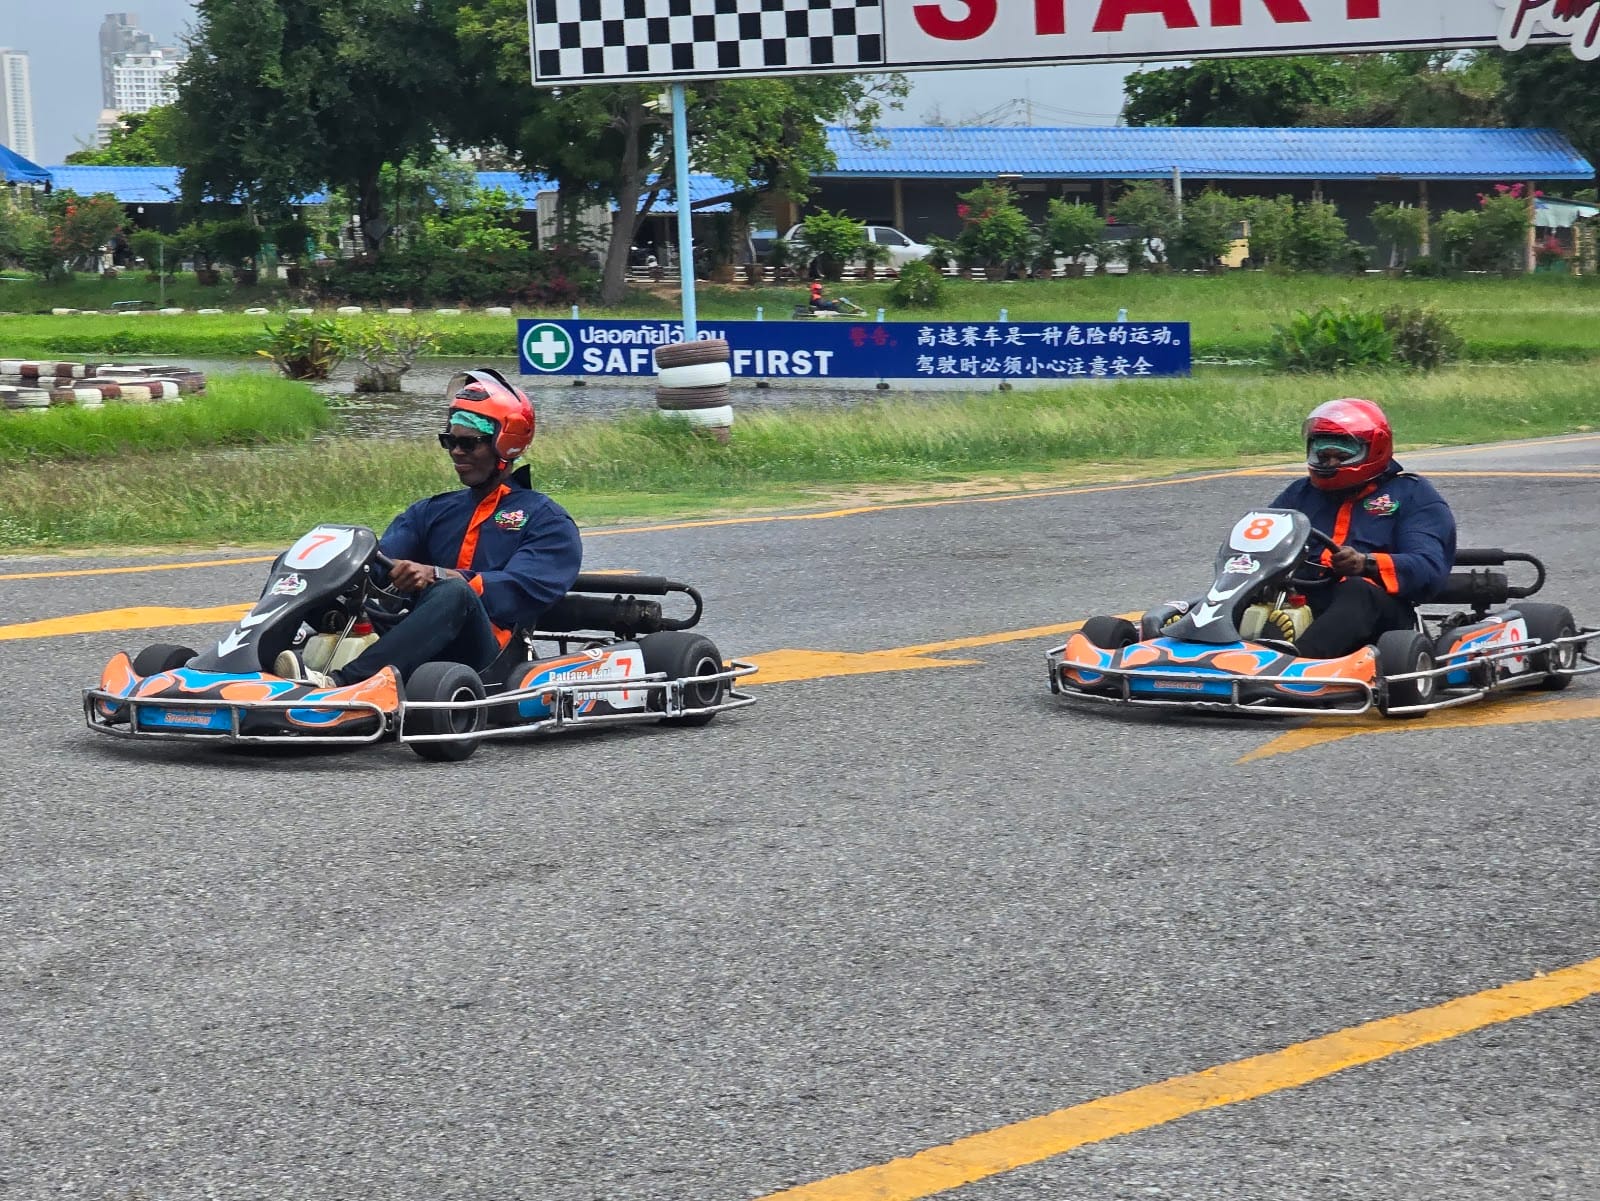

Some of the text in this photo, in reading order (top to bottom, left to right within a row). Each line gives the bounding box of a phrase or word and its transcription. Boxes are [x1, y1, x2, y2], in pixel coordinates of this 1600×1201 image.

[917, 325, 1182, 347] 高速赛车是一种危险的运动。
[733, 349, 834, 375] FIRST
[916, 355, 1155, 376] 驾驶时必须小心注意安全
[1243, 518, 1274, 540] 8
[297, 534, 337, 560] 7
[616, 657, 632, 701] 7
